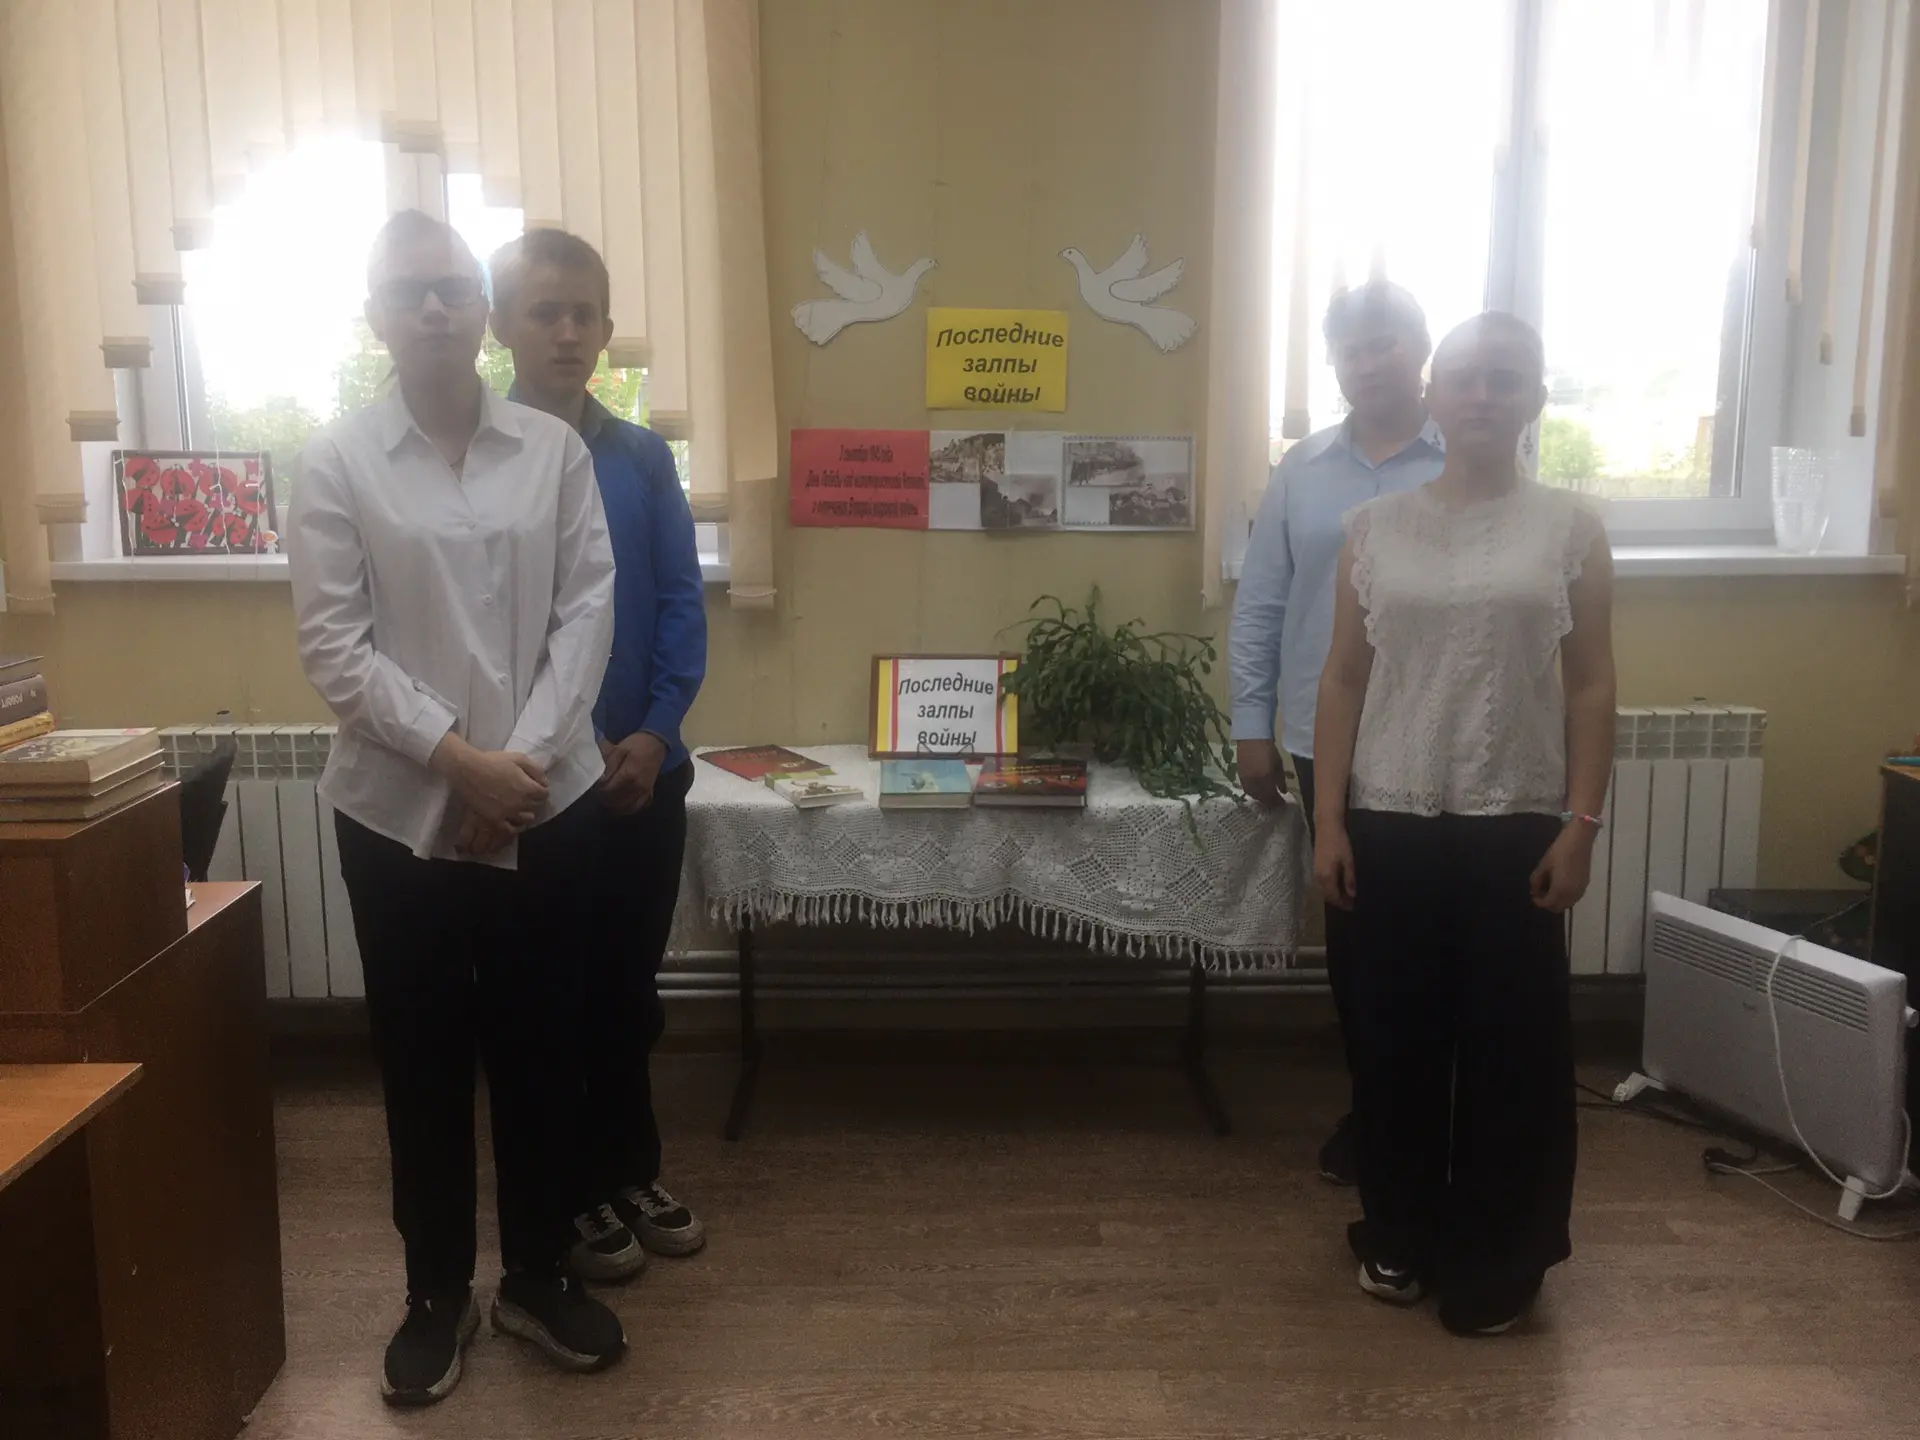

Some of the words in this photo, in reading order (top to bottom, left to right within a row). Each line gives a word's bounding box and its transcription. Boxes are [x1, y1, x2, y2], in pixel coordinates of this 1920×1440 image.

[936, 322, 1064, 347] Последние
[962, 357, 1038, 373] залпы
[963, 382, 1041, 404] войны
[898, 672, 994, 695] Последние
[917, 704, 974, 719] залпы
[917, 727, 977, 746] войны
